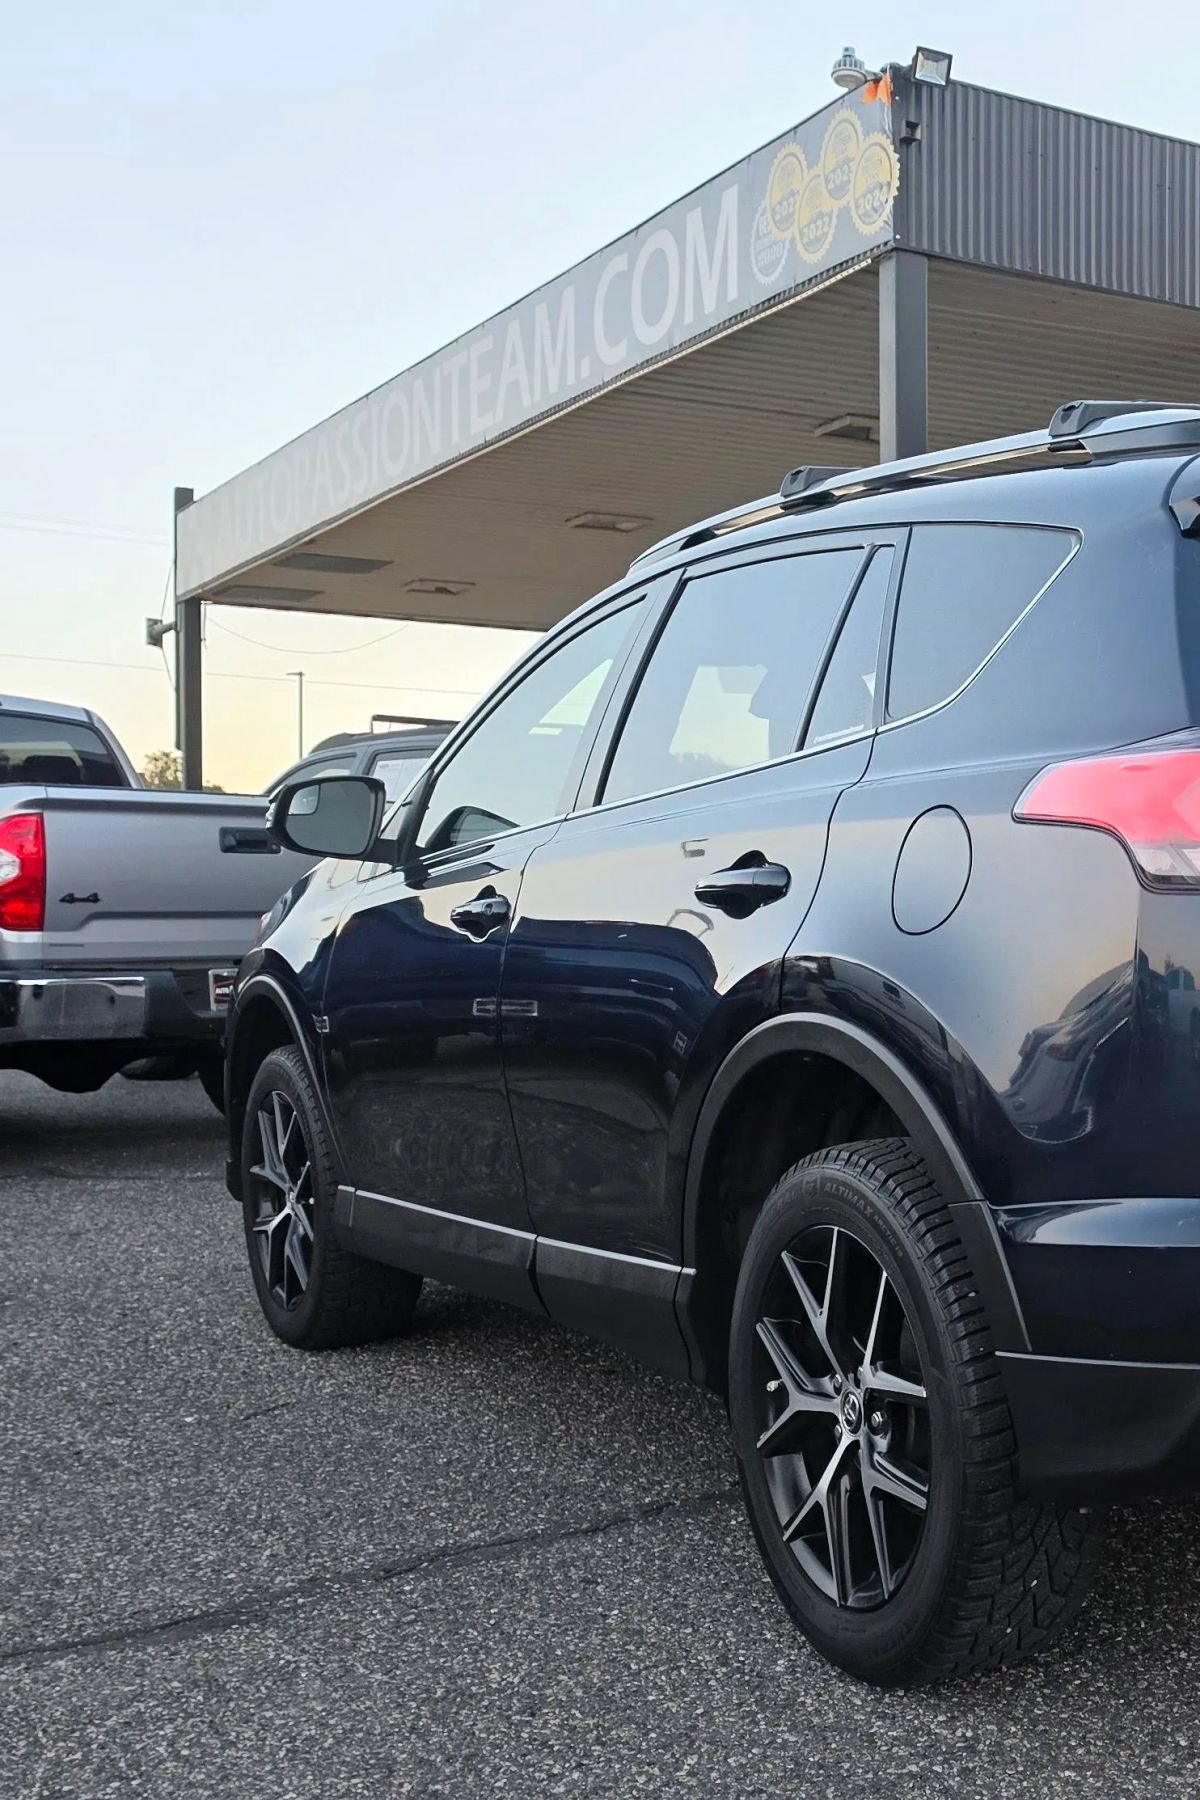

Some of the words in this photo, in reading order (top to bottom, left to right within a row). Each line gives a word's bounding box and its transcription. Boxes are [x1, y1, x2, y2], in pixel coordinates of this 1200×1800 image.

[857, 188, 889, 215] 2024
[215, 183, 739, 556] AUTOPASSIONTEAM.COM
[824, 1182, 874, 1218] ALTIMAX
